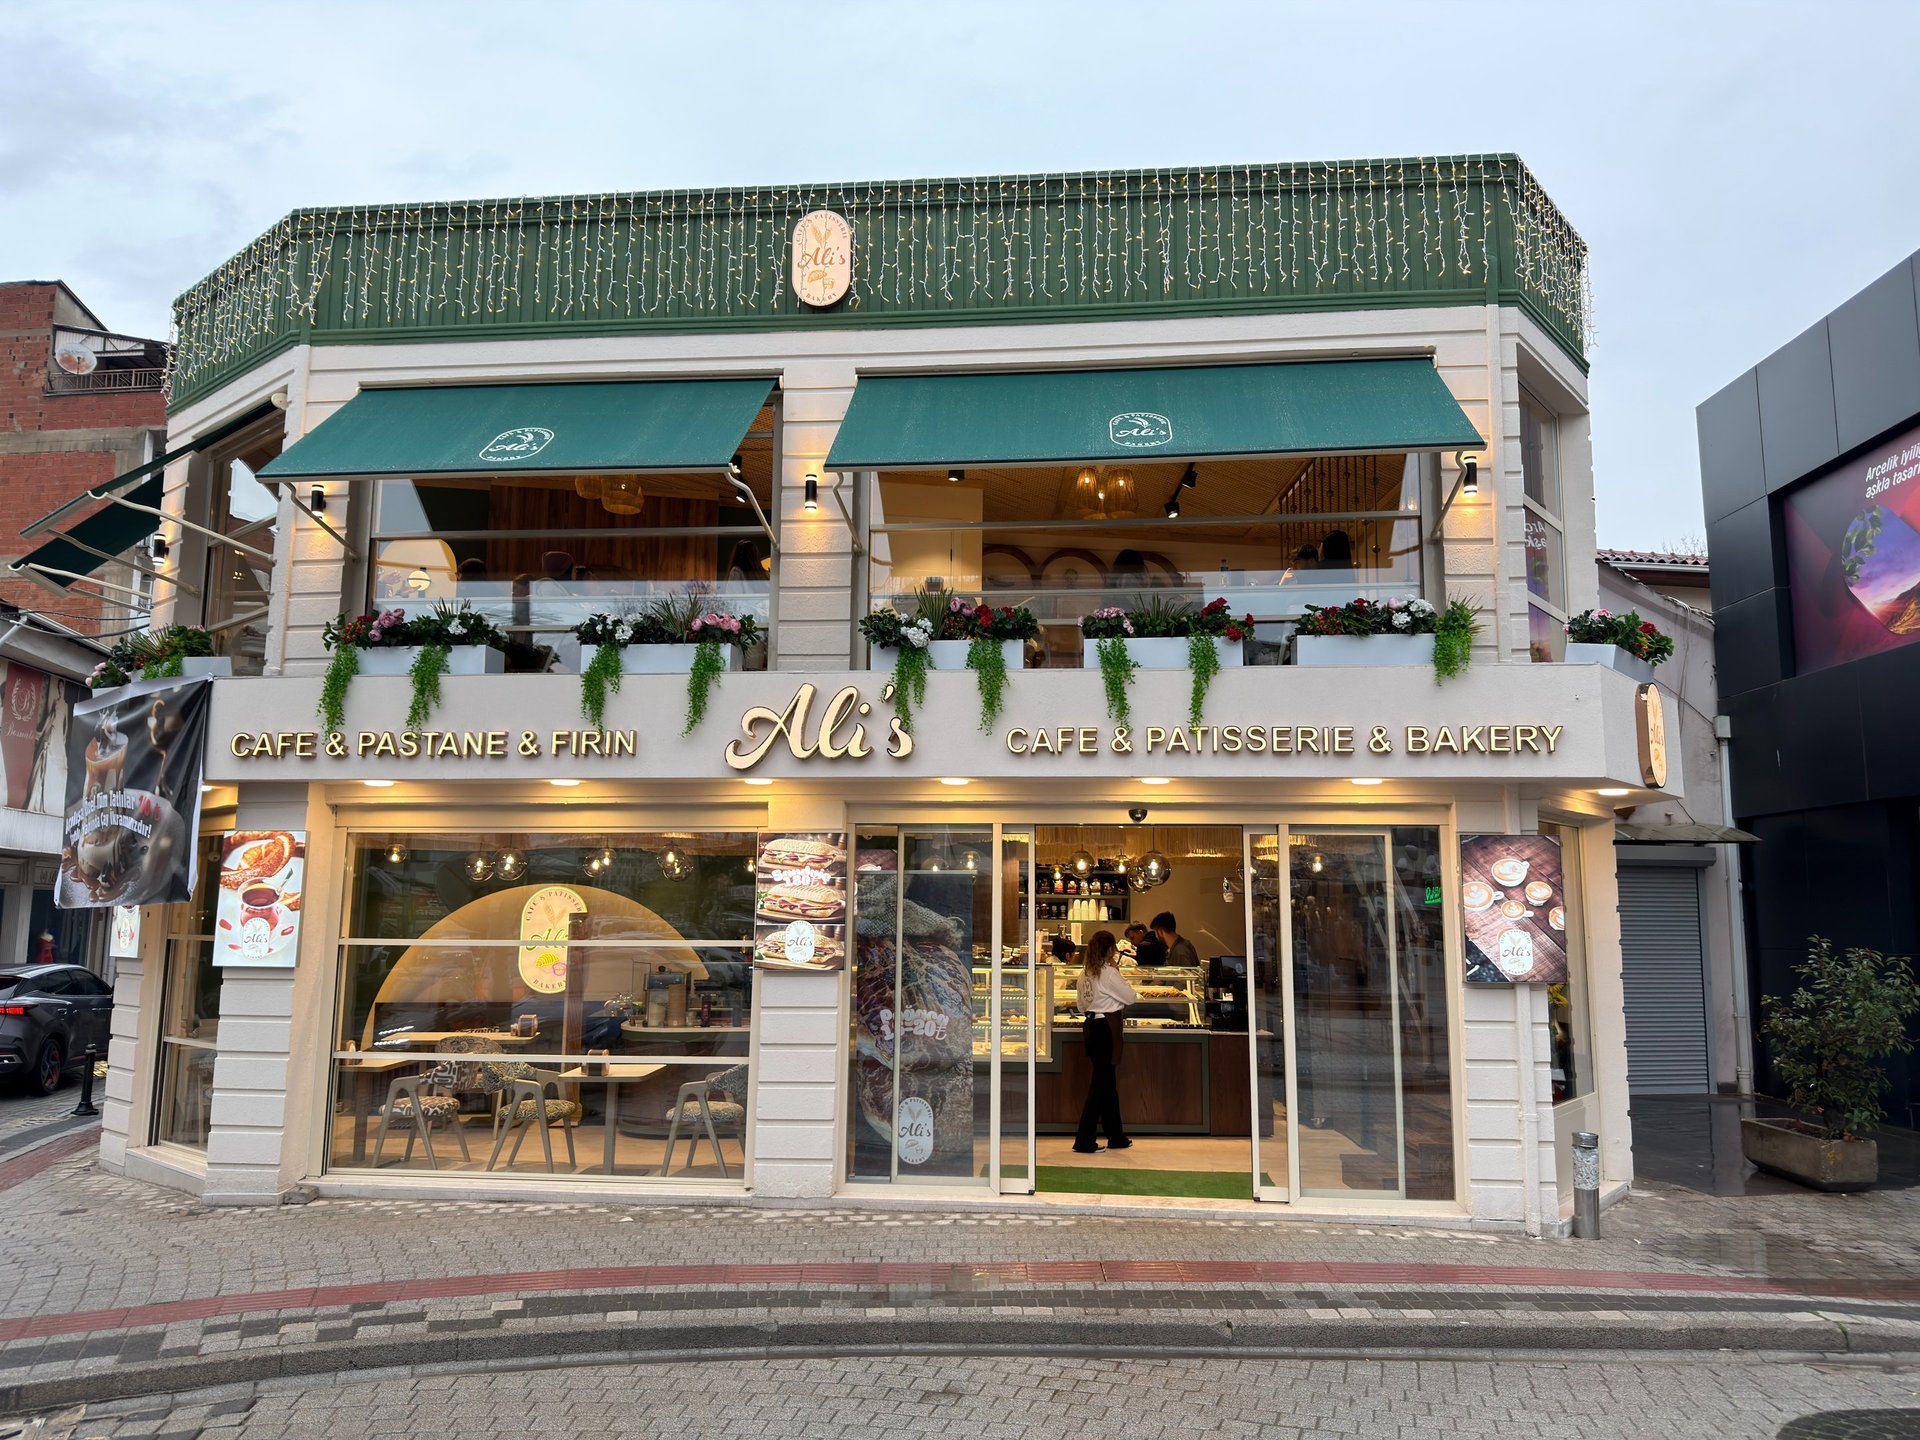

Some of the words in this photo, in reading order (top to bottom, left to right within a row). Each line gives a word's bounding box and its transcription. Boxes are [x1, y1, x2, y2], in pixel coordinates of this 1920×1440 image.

[797, 246, 846, 269] Ali's
[1865, 454, 1899, 482] Arçelik
[1865, 477, 1890, 499] aşkla
[724, 682, 916, 770] Ali's
[230, 732, 317, 758] CAFE
[325, 731, 349, 757] &
[357, 731, 509, 757] PASTANE
[517, 730, 542, 757] &
[551, 730, 637, 756] FIRIN
[1006, 726, 1099, 754] CAFE
[1111, 726, 1133, 753] &
[1146, 725, 1355, 754] PATISSERIE
[1368, 725, 1393, 753] &
[1405, 725, 1564, 754] BAKERY
[526, 902, 538, 921] CAFE
[244, 933, 268, 944] Ali's
[787, 936, 813, 947] Ali's
[1501, 946, 1531, 958] Ali's
[898, 1122, 931, 1138] Ali's
